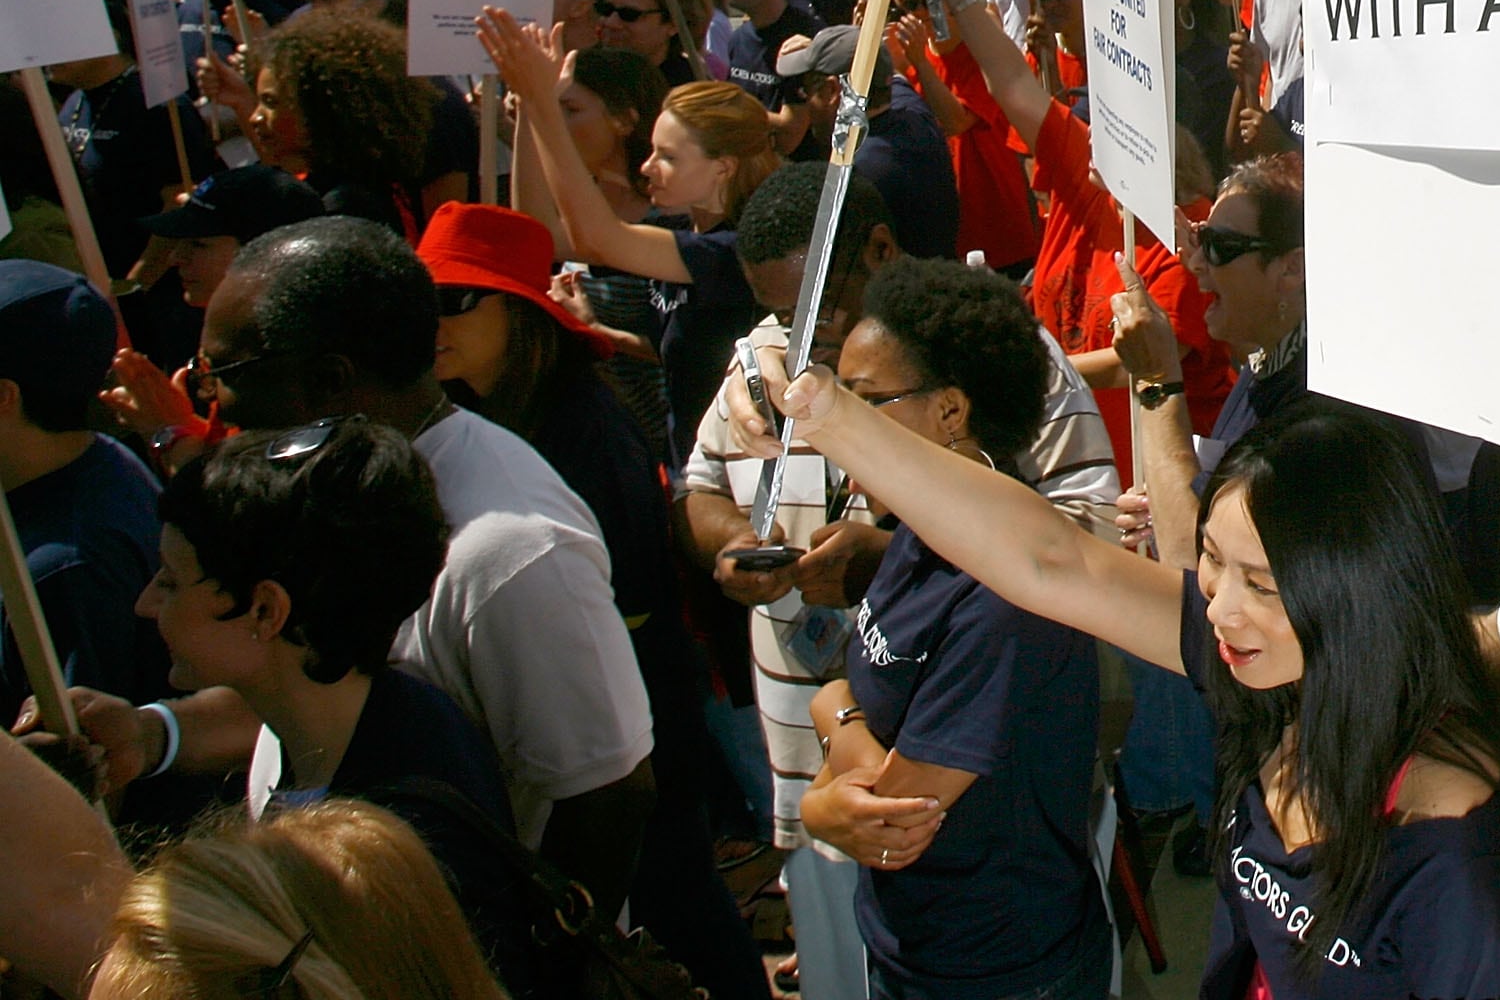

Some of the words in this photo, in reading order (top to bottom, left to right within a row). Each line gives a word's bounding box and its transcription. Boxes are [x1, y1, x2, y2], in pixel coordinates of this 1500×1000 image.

[1110, 9, 1127, 39] FOR
[1093, 27, 1106, 54] FAIR
[1107, 38, 1152, 91] CONTRACTS
